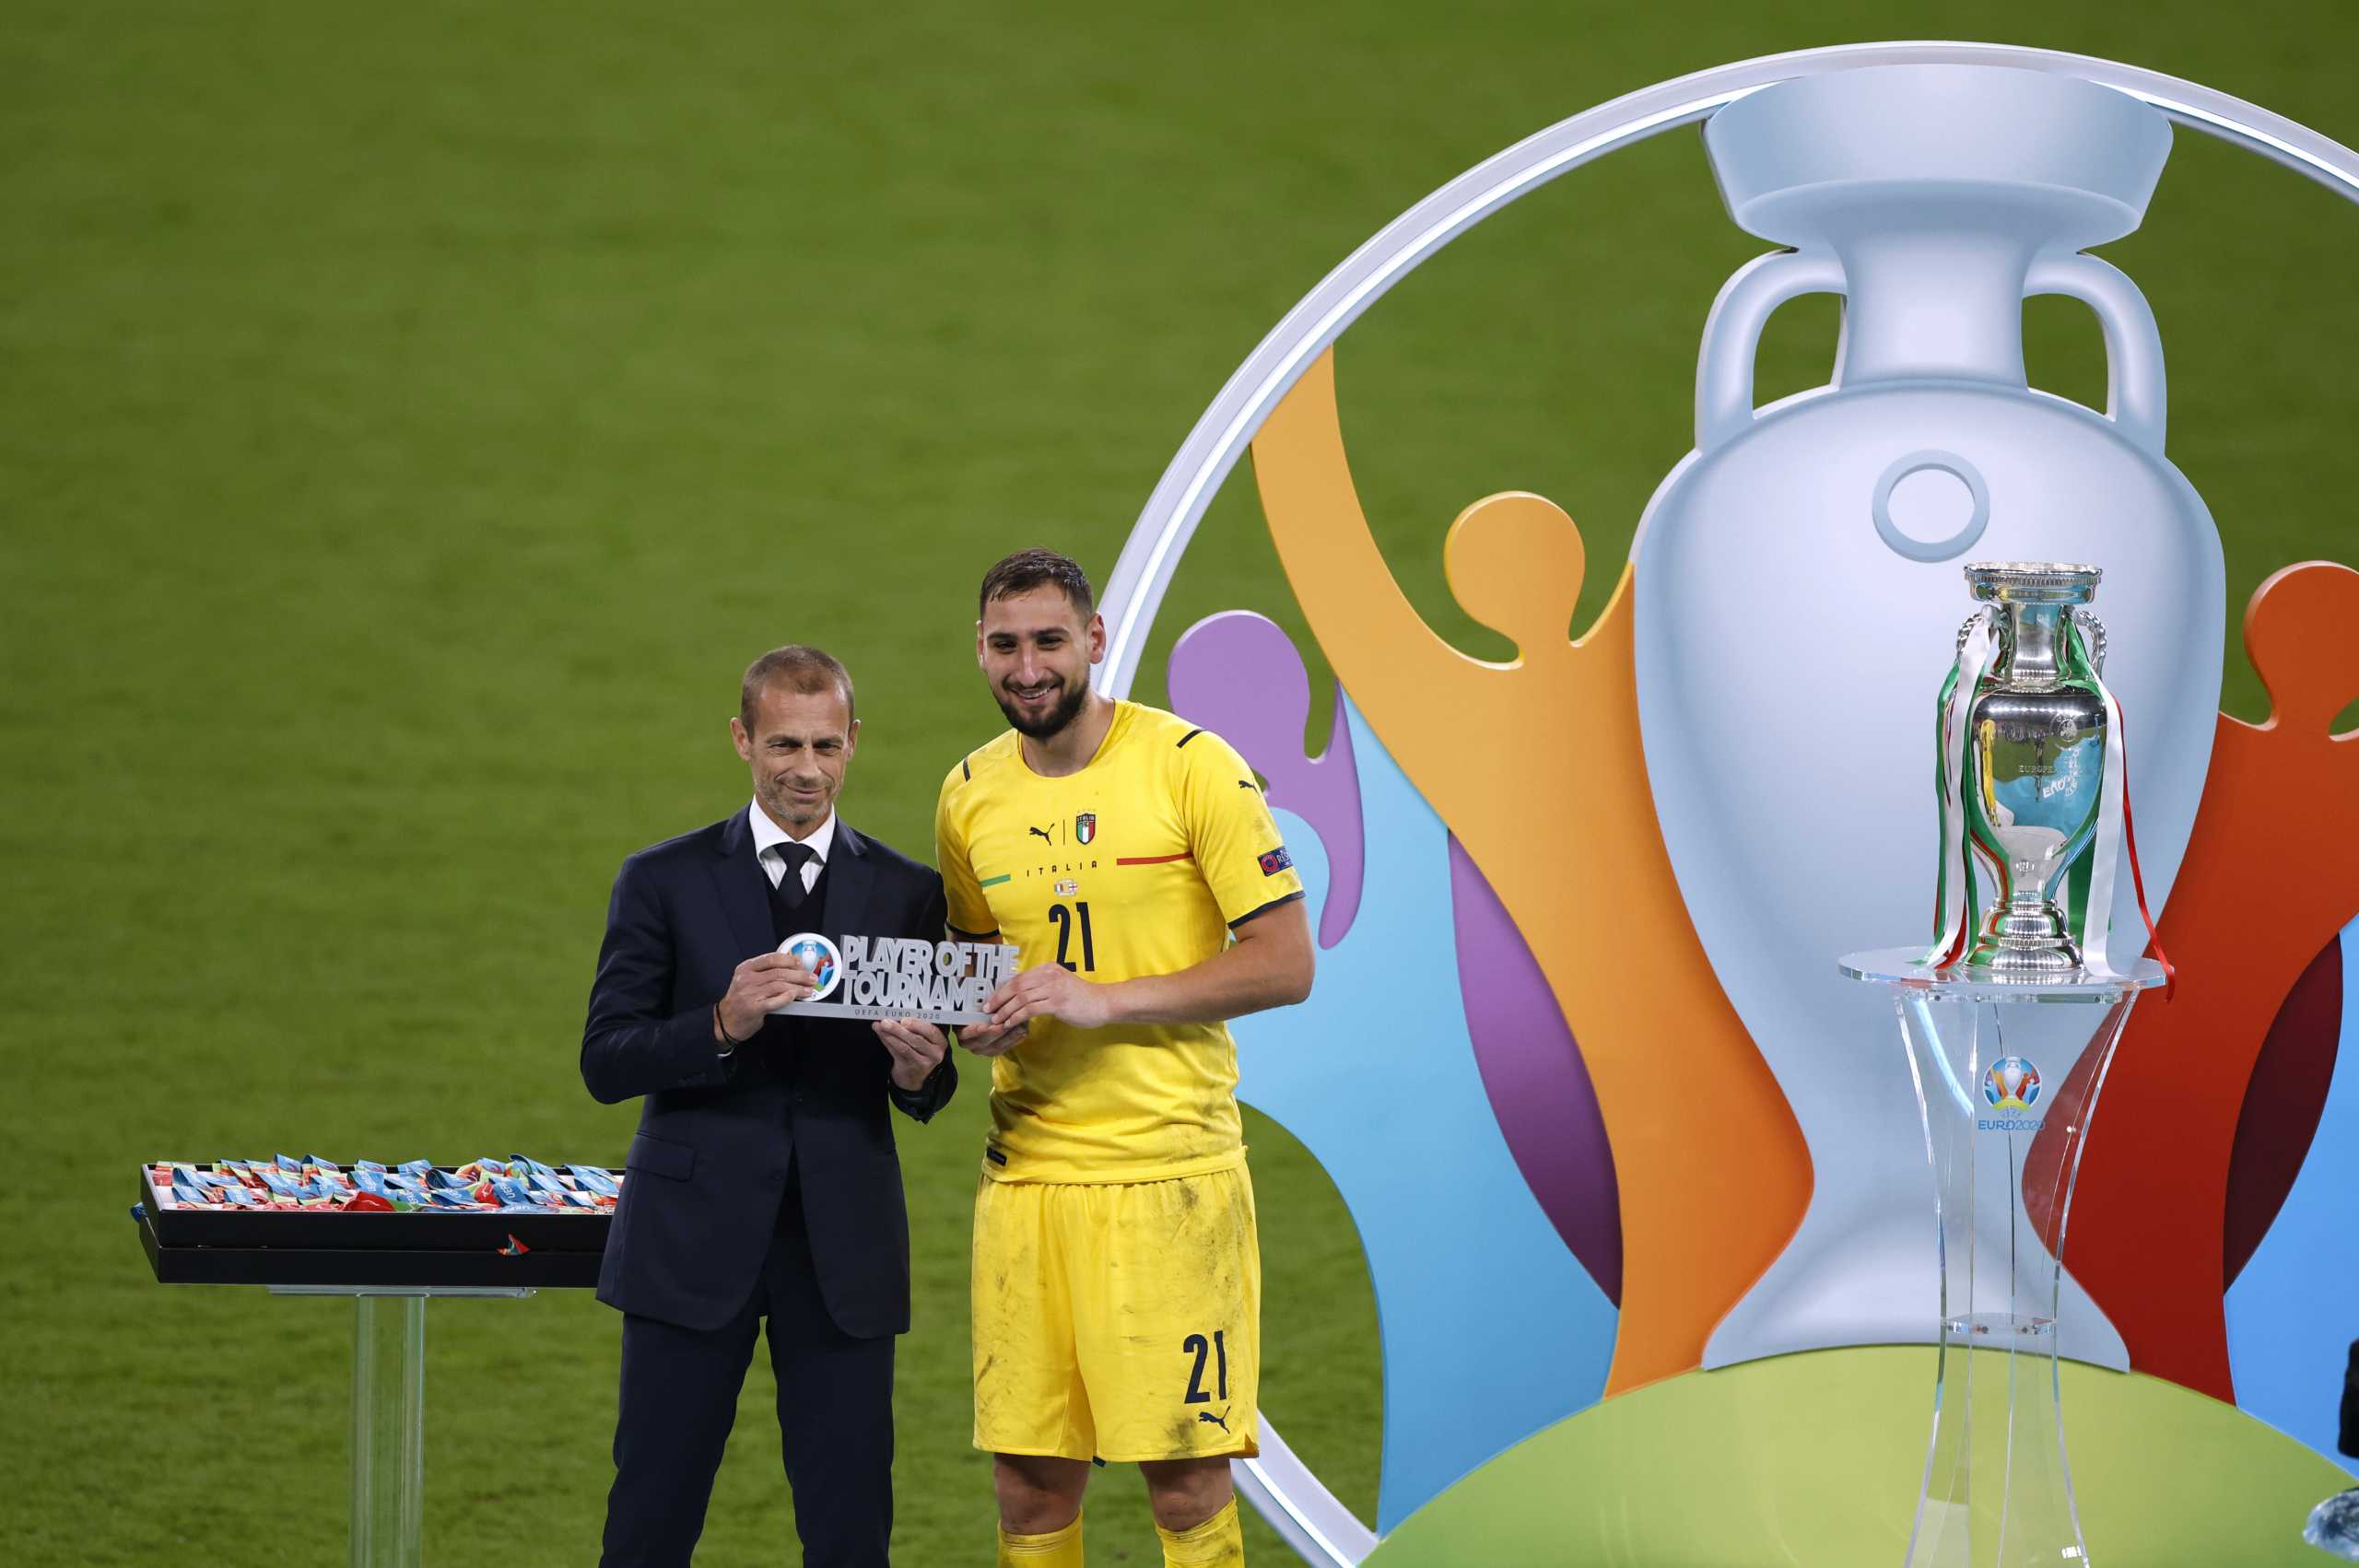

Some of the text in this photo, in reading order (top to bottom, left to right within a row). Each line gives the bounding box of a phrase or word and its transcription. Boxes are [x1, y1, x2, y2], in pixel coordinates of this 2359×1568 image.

[1027, 860, 1097, 877] ITALIA
[840, 934, 1020, 980] PLAYER OF THE
[1048, 901, 1096, 973] 21
[841, 970, 1000, 1012] TOURNAME
[854, 1009, 879, 1017] UEFA
[885, 1010, 911, 1018] EURO
[1978, 1119, 2046, 1131] EURO2020
[1182, 1330, 1226, 1404] 21
